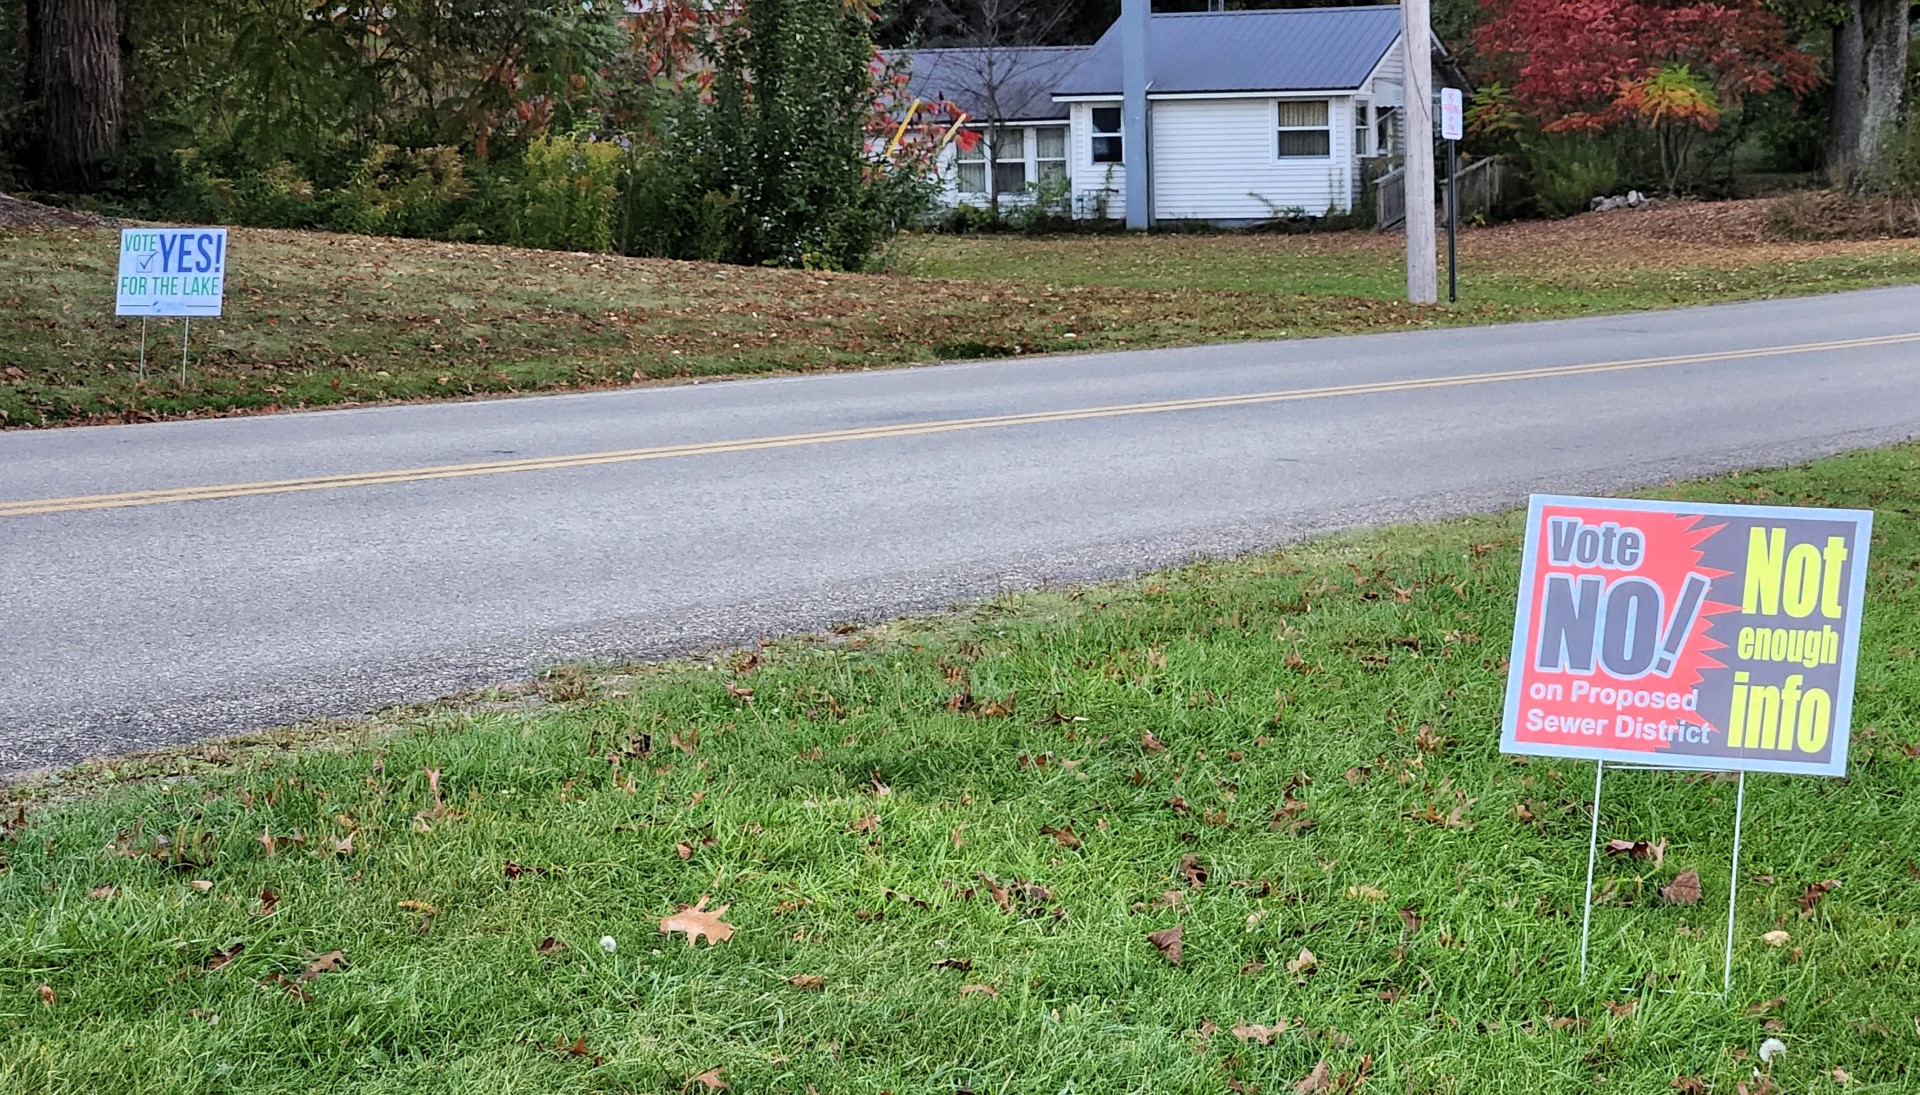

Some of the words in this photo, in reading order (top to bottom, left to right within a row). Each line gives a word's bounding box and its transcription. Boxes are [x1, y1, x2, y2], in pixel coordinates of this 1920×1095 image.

[124, 234, 157, 252] VOTE
[159, 234, 222, 273] YES!
[120, 276, 147, 296] FOR
[152, 276, 179, 296] THE
[183, 276, 220, 296] LAKE
[1548, 517, 1645, 570] Vote
[1742, 526, 1848, 619] Not
[1537, 573, 1710, 679] NO!
[1738, 625, 1838, 668] enough
[1530, 681, 1563, 701] on
[1571, 681, 1698, 711] Proposed
[1727, 671, 1831, 754] info
[1526, 709, 1607, 736] Sewer
[1615, 714, 1711, 744] District
